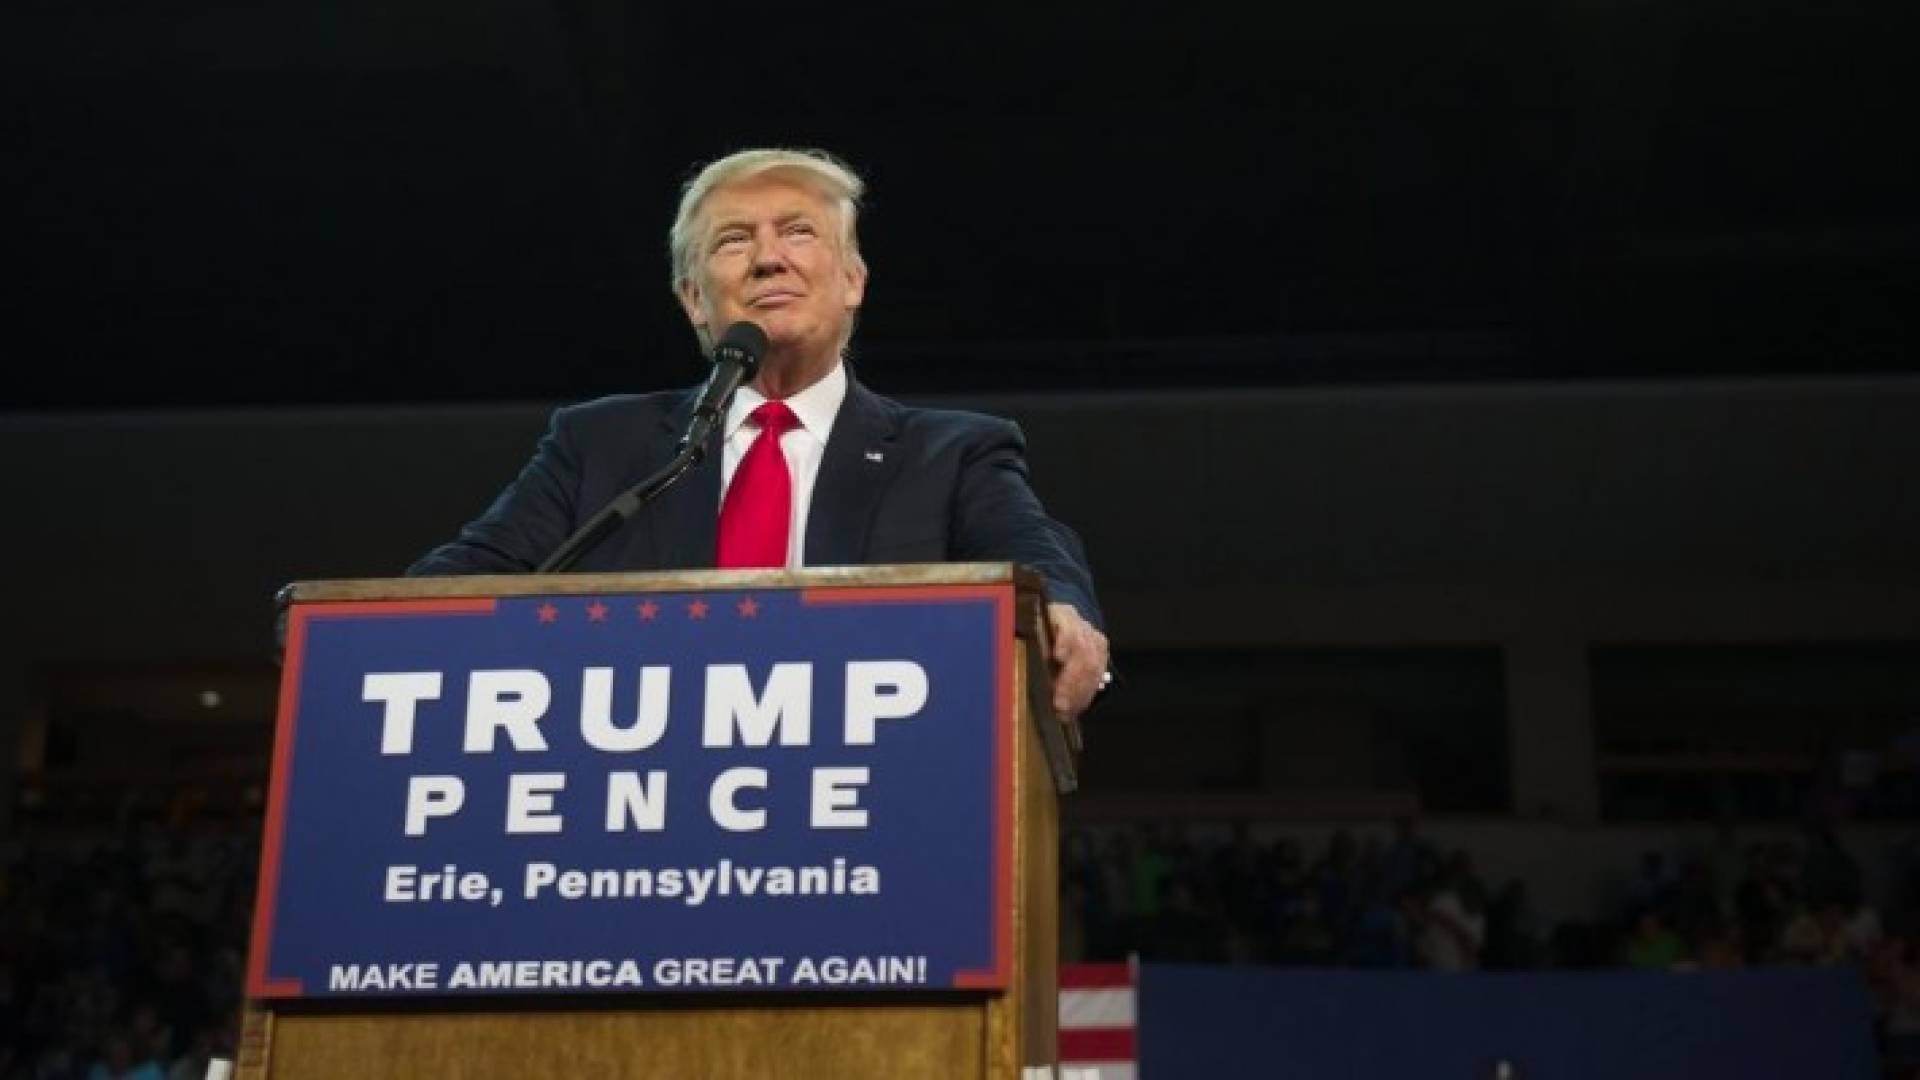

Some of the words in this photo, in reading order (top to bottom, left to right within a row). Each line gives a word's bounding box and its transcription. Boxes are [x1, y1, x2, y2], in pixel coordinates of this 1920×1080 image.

[361, 660, 931, 755] TRUMP
[404, 766, 870, 836] PENCE
[384, 864, 504, 906] Erie,
[523, 857, 880, 906] Pennsylvania
[329, 963, 438, 991] MAKE
[447, 959, 643, 988] AMERICA
[652, 957, 782, 987] GREAT
[791, 954, 928, 984] AGAIN!
